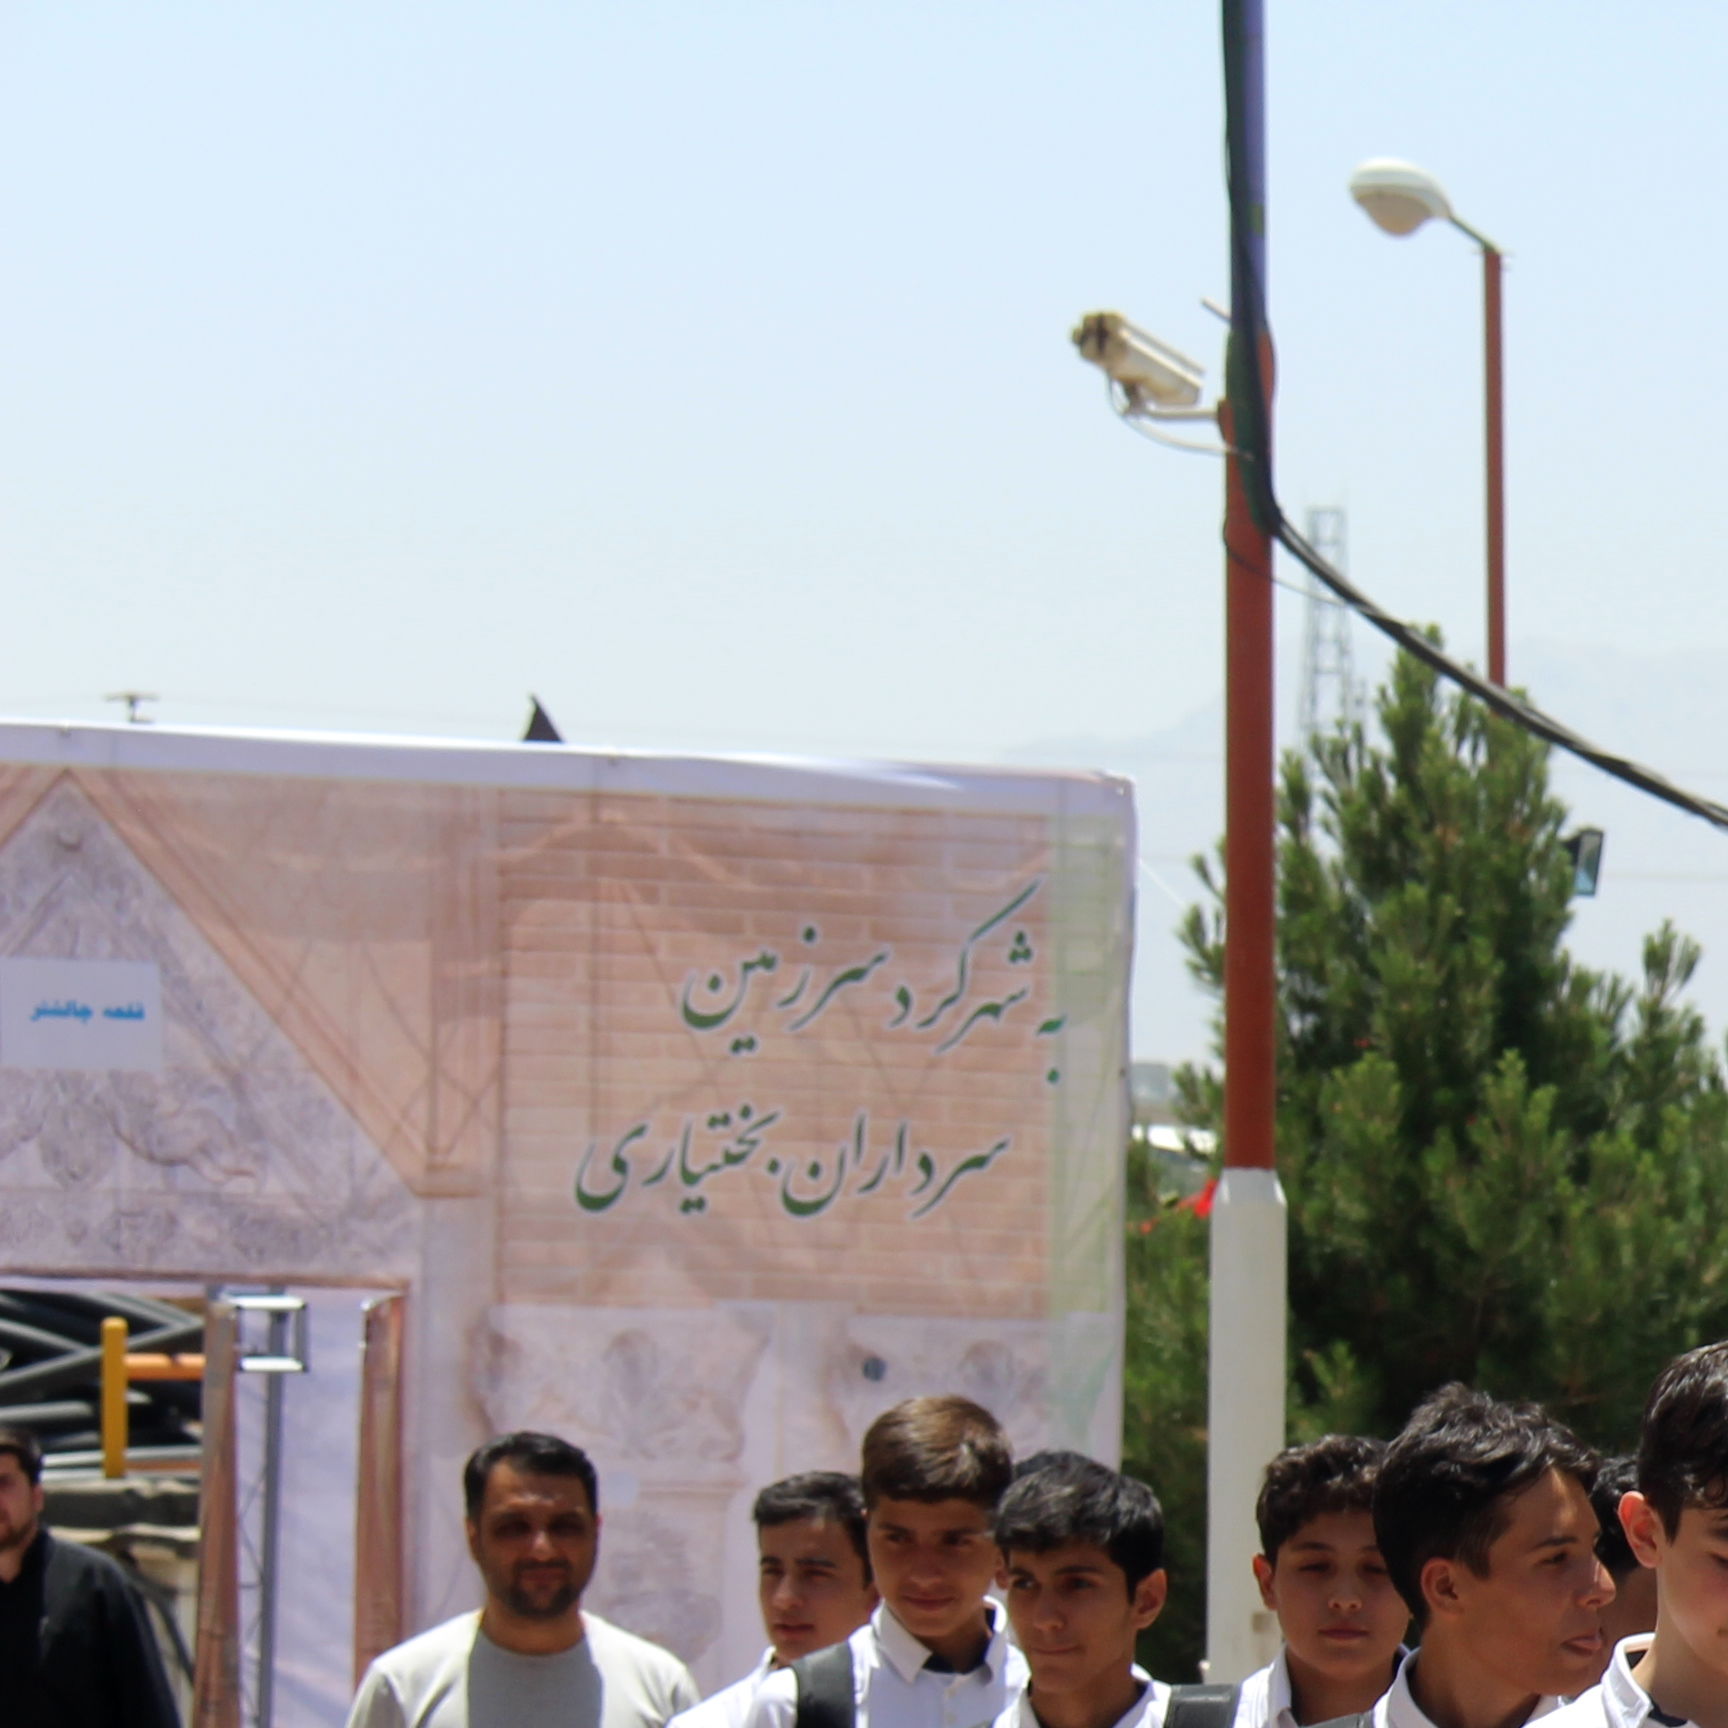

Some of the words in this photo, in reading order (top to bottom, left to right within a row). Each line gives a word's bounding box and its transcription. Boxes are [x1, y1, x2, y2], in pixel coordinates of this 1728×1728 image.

[681, 925, 888, 1055] سرزمین
[890, 880, 1041, 1055] شهرکرد
[1035, 1014, 1067, 1085] به
[574, 1105, 781, 1215] بختیاری
[781, 1113, 1011, 1218] سرداران
